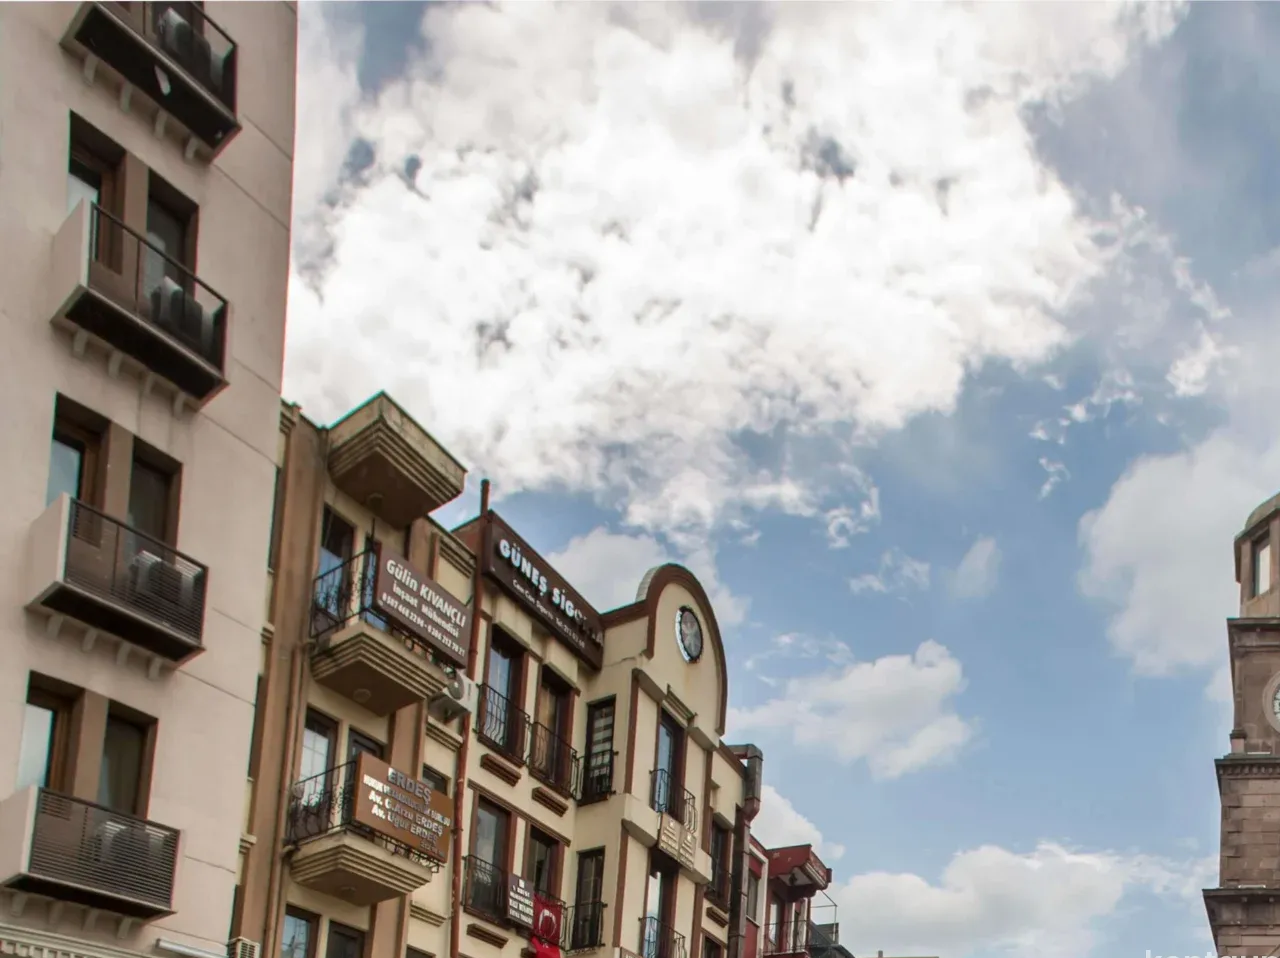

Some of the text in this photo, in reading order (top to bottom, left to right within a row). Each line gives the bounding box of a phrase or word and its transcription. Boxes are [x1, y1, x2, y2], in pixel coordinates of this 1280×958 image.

[500, 539, 548, 596] GÜNEŞ
[386, 559, 466, 627] Gülin KIVANÇLI
[388, 767, 432, 805] ERDEŞ
[368, 790, 383, 806] Av.
[416, 815, 443, 836] ERDEŞ
[371, 804, 385, 819] Av.
[410, 824, 437, 845] ERDEŞ
